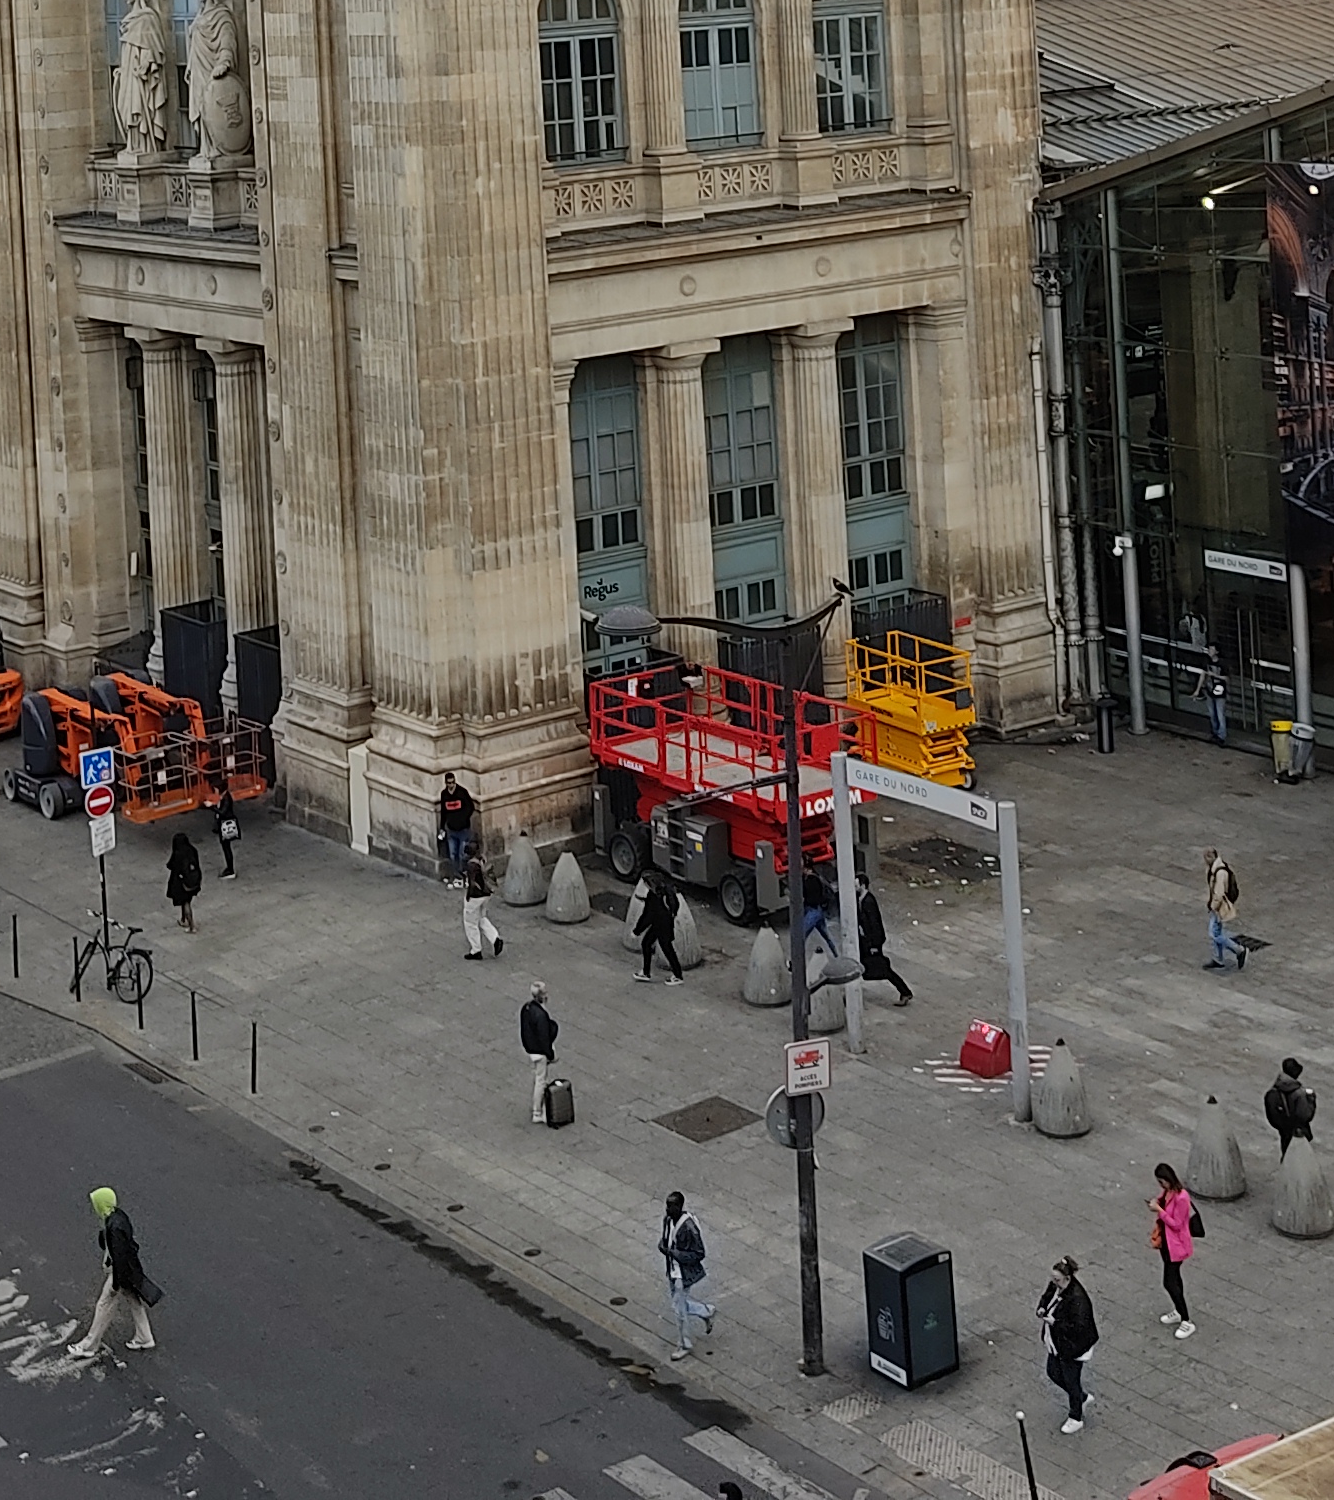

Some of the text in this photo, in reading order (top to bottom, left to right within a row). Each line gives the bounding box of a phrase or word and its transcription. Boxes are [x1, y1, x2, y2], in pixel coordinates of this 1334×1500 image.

[1208, 555, 1225, 566] GARE
[1227, 558, 1237, 567] DU
[1238, 561, 1258, 571] NORD
[584, 579, 619, 601] Regus
[855, 769, 880, 785] GARE
[883, 777, 897, 789] DU
[900, 782, 927, 798] NORD
[806, 789, 862, 817] LOXM
[794, 1079, 823, 1089] POMPIERS
